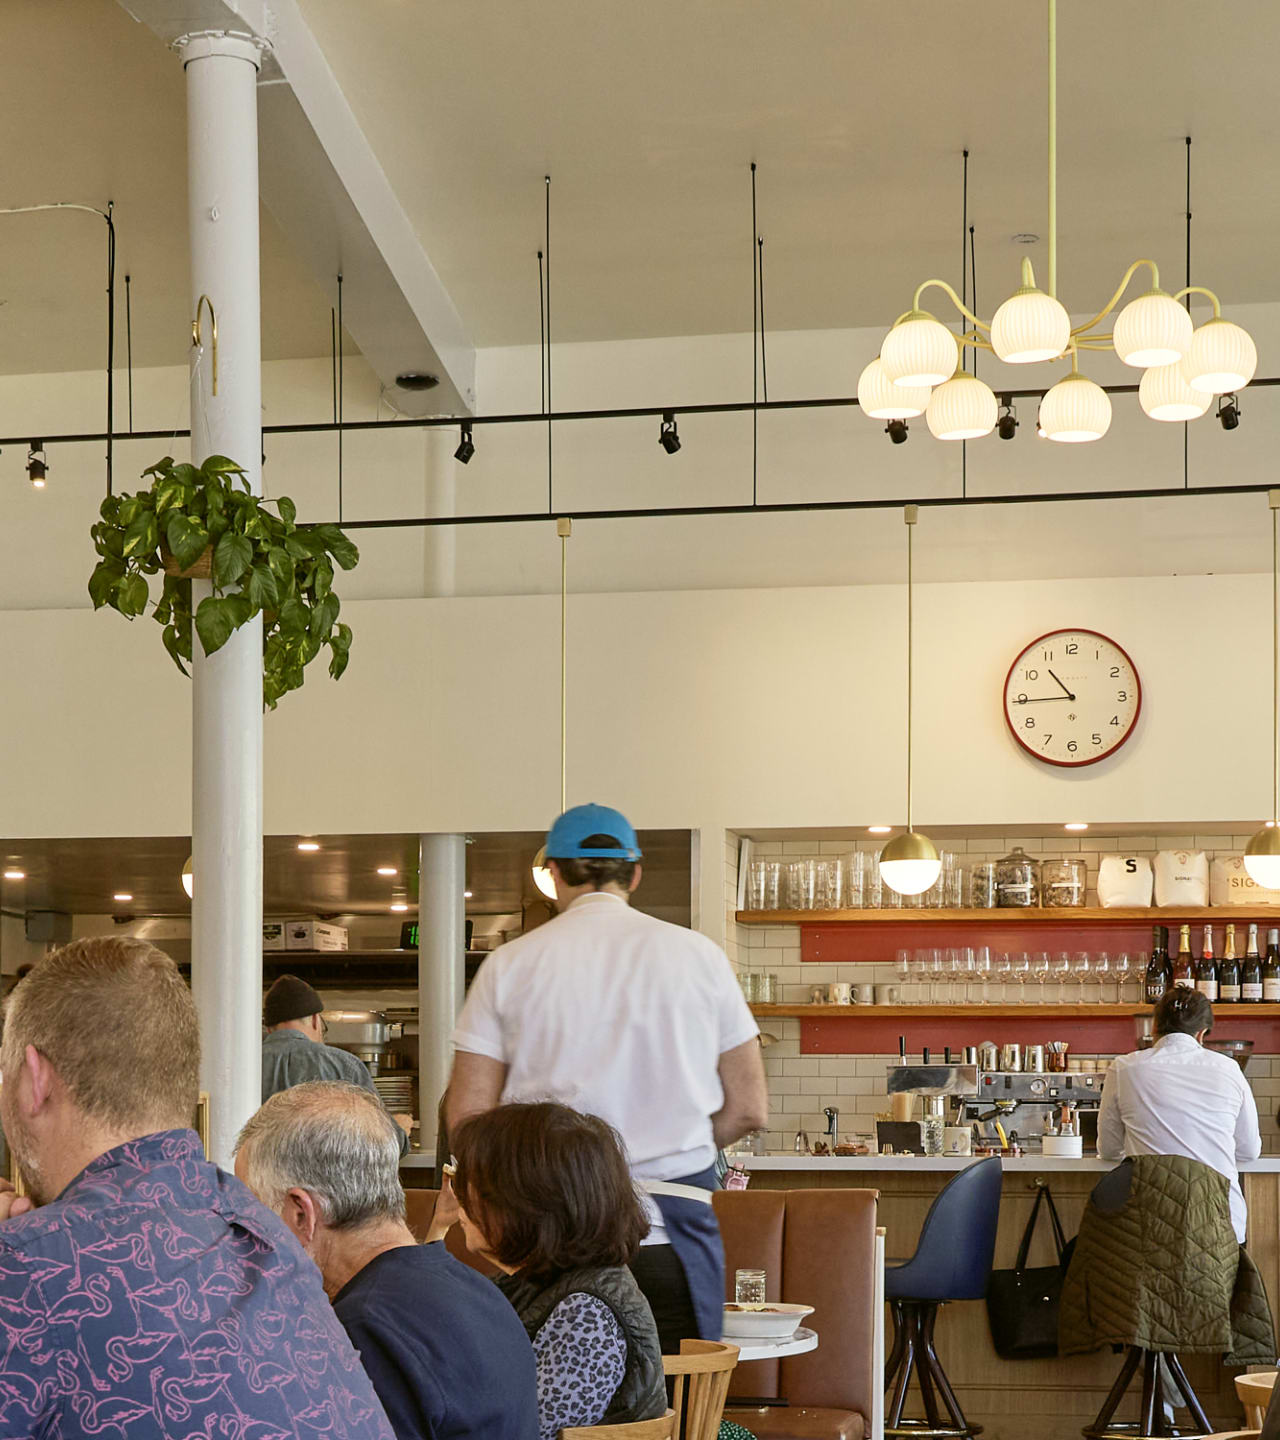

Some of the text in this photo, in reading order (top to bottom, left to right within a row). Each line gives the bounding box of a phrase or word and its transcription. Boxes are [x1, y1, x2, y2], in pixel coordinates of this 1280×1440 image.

[1065, 643, 1079, 655] 12
[1044, 651, 1053, 661] 11
[1025, 670, 1039, 681] 10
[1109, 666, 1120, 678] 2
[1017, 693, 1028, 705] 9
[1117, 691, 1127, 702] 3
[1025, 717, 1036, 729] 8
[1109, 715, 1119, 726] 4
[1044, 734, 1053, 745] 7
[1091, 733, 1102, 745] 5
[1067, 740, 1078, 752] 6
[1125, 858, 1137, 873] S
[1231, 877, 1260, 888] SIG
